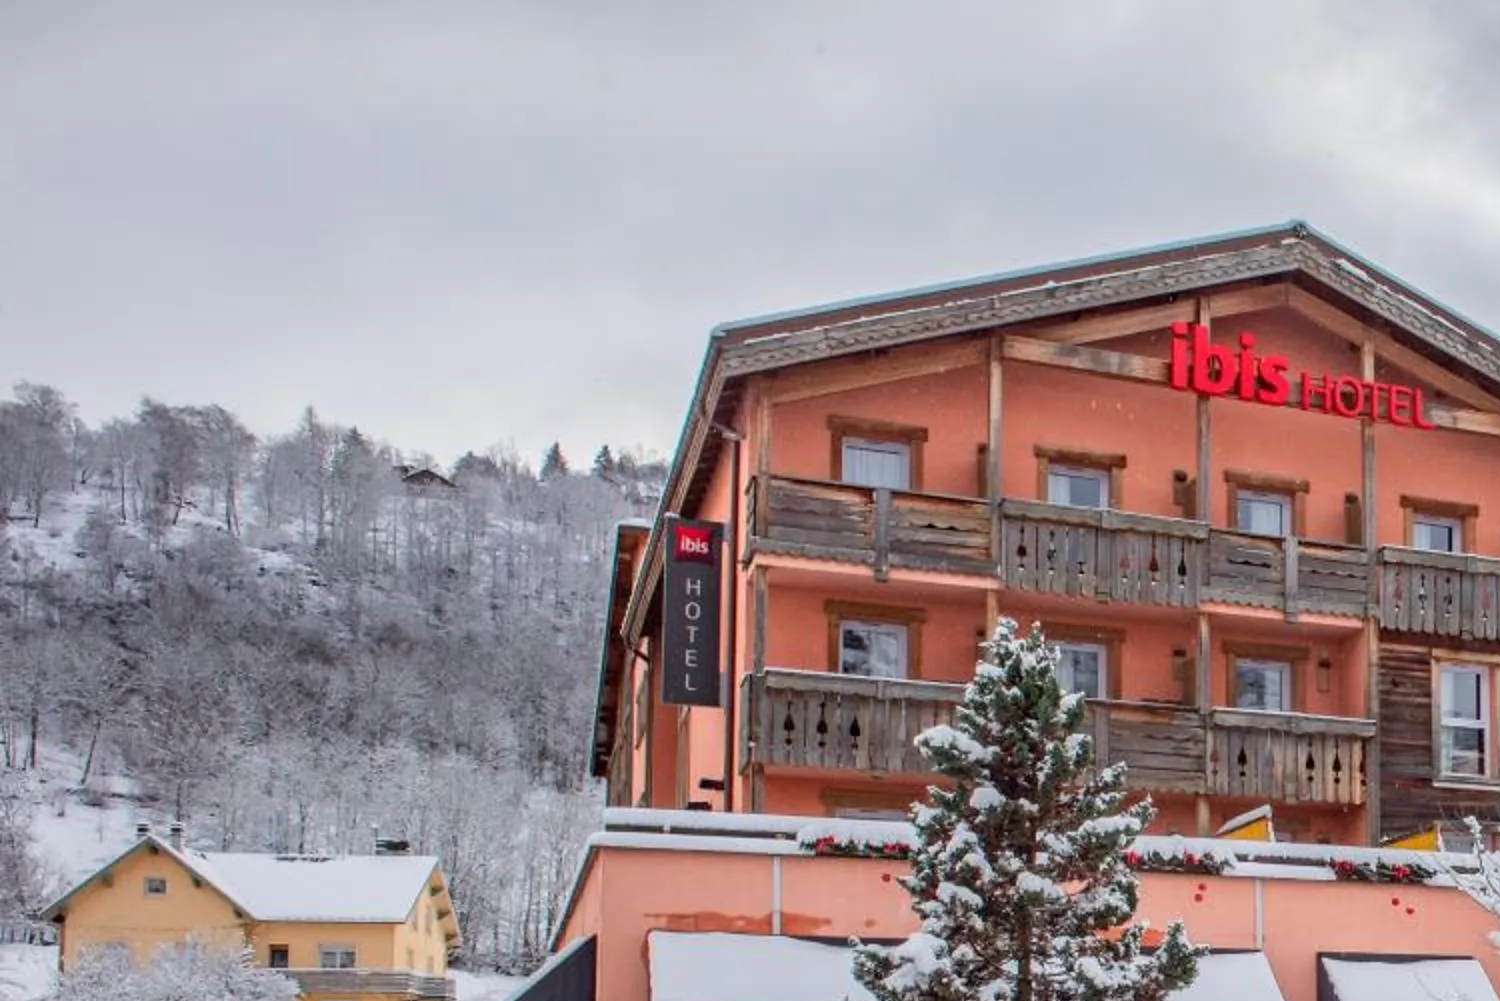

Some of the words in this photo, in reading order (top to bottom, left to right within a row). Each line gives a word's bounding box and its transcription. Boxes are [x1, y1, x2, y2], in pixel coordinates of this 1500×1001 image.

[1169, 321, 1291, 406] ibis
[1301, 370, 1436, 430] HOTEL
[680, 535, 709, 554] ibis
[684, 577, 701, 691] HOTEL
